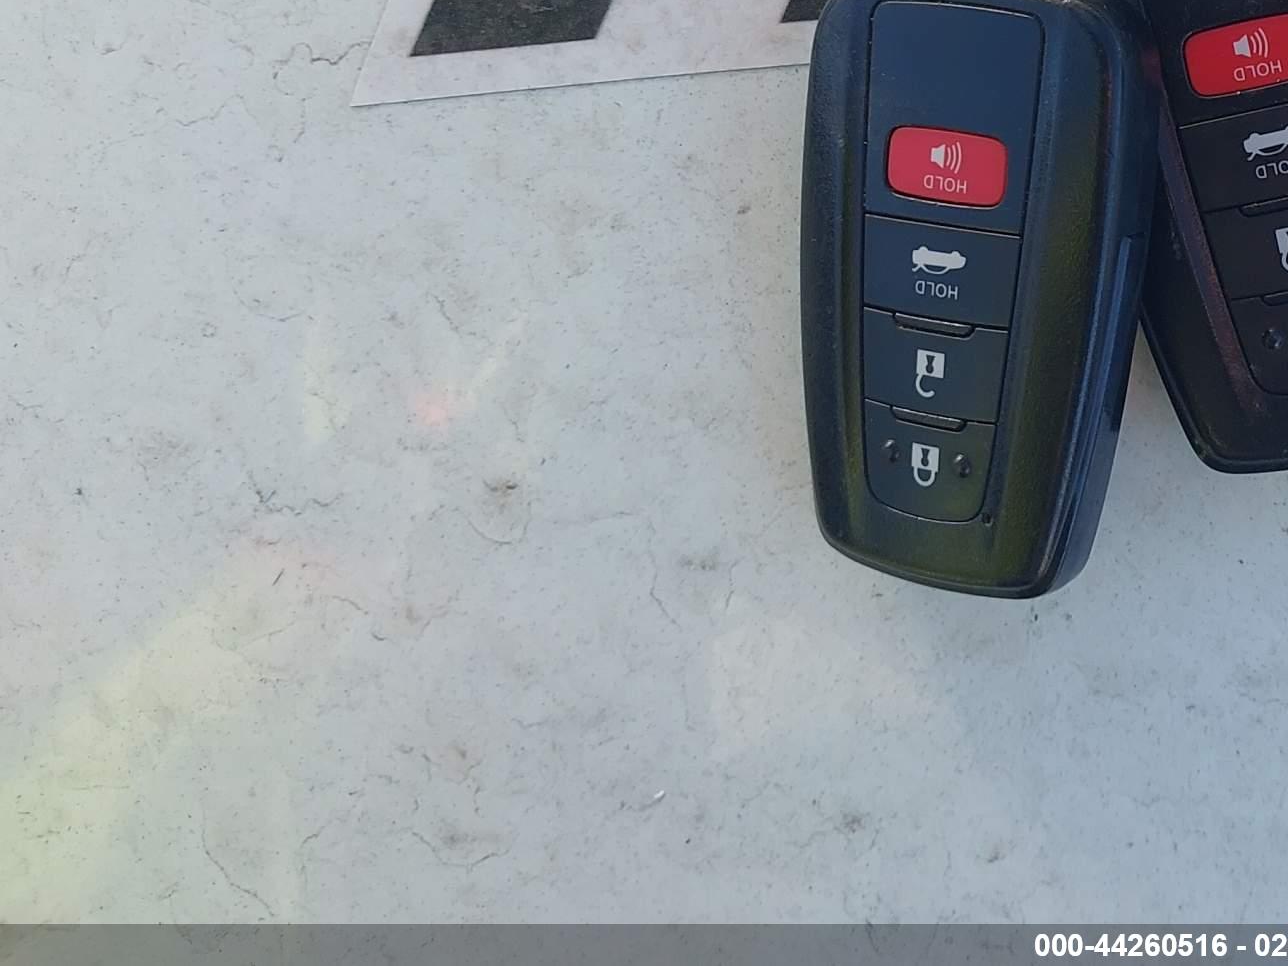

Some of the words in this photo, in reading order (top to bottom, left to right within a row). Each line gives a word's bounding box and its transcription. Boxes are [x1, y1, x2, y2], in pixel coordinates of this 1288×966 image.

[1233, 59, 1282, 83] HOLD
[923, 174, 967, 194] HOLD
[915, 280, 959, 300] HOLD
